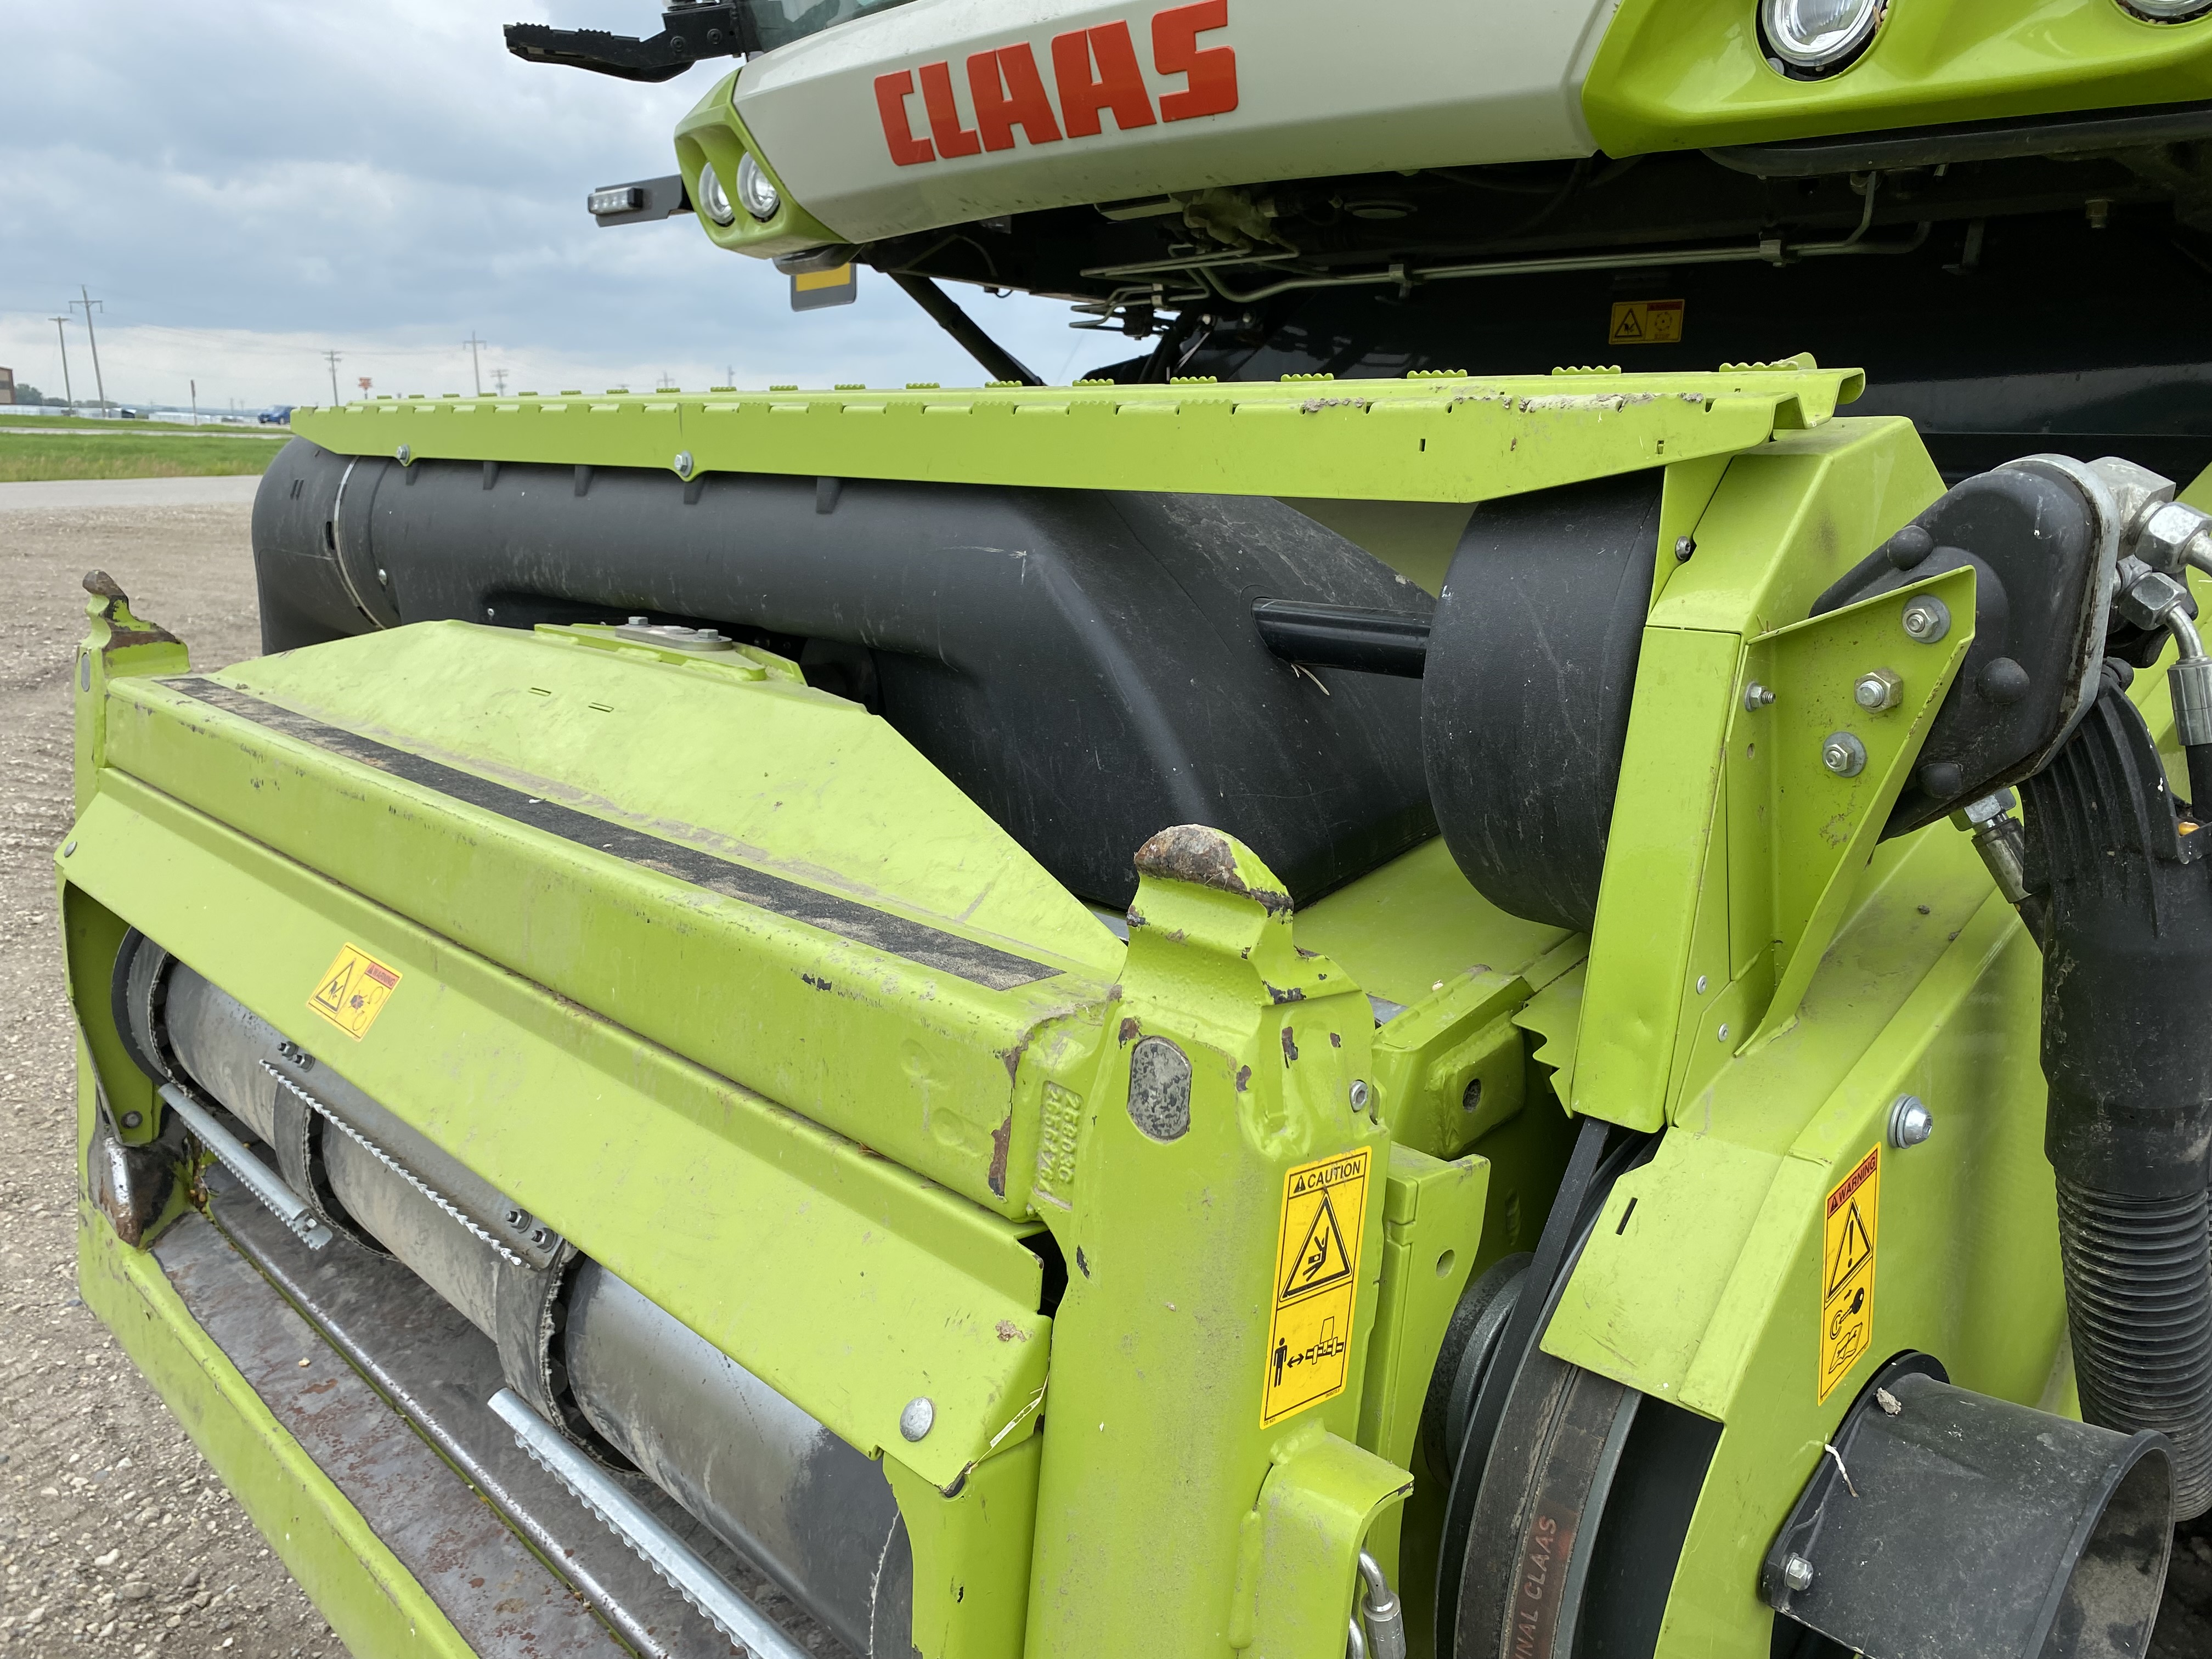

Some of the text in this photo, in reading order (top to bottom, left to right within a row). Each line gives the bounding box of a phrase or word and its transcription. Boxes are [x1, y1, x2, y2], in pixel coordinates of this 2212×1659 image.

[874, 0, 1239, 166] CLAAS
[372, 968, 396, 987] WARNING
[1307, 1159, 1361, 1189] CAUTION
[1838, 1156, 1876, 1200] WARNING
[1524, 1515, 1557, 1600] CLAAS
